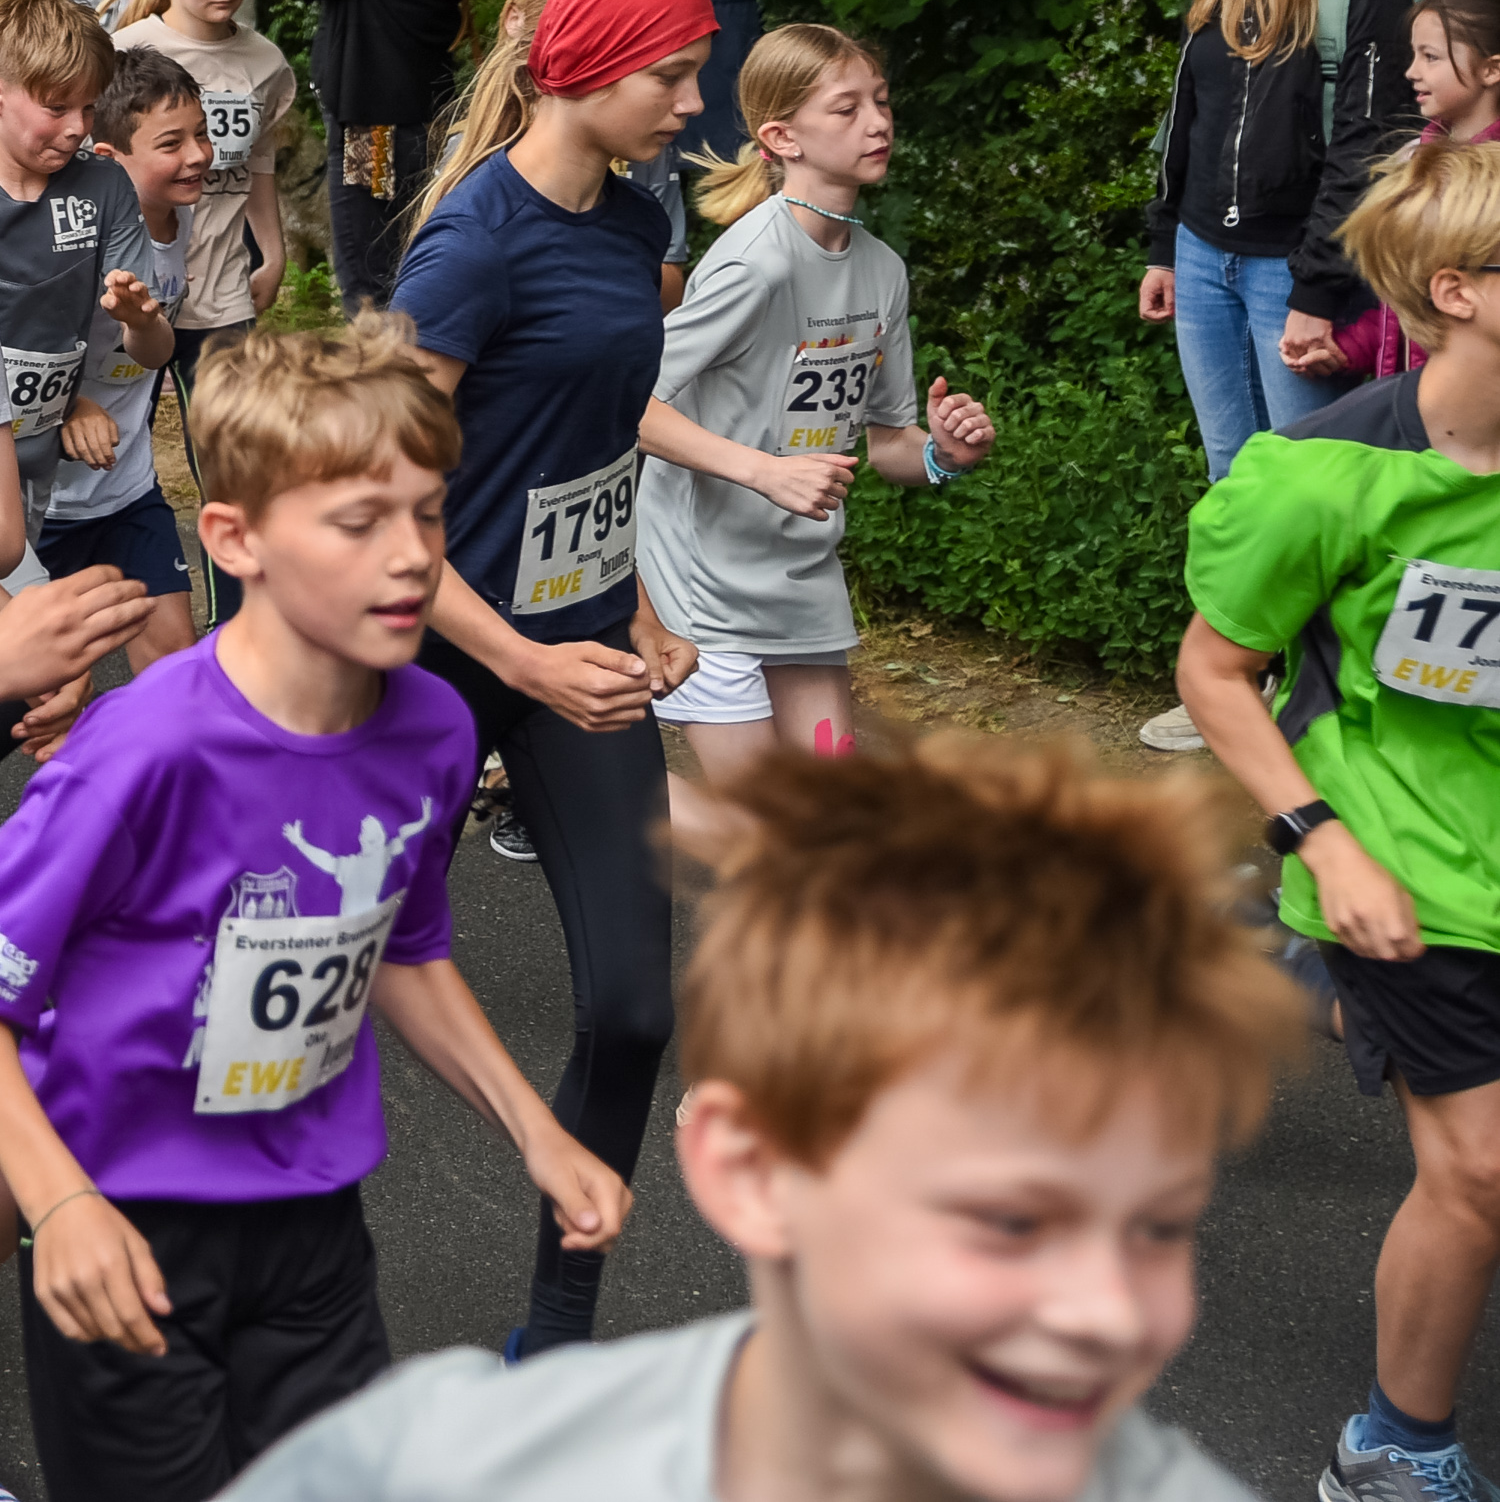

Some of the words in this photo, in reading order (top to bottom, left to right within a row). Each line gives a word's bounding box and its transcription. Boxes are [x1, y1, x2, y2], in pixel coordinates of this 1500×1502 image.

[210, 108, 251, 137] 35
[806, 316, 846, 328] Everstener
[801, 353, 849, 367] Everstener
[787, 363, 877, 412] 233
[788, 426, 839, 448] EWE
[539, 484, 592, 509] Everstener
[531, 475, 633, 561] 1799
[576, 548, 603, 564] Romy
[600, 547, 631, 579] bruns
[530, 568, 585, 604] EWE
[1405, 592, 1500, 650] 17
[1393, 657, 1479, 694] EWE
[235, 935, 333, 950] Everstener
[251, 940, 377, 1032] 628
[222, 1057, 307, 1097] EWE
